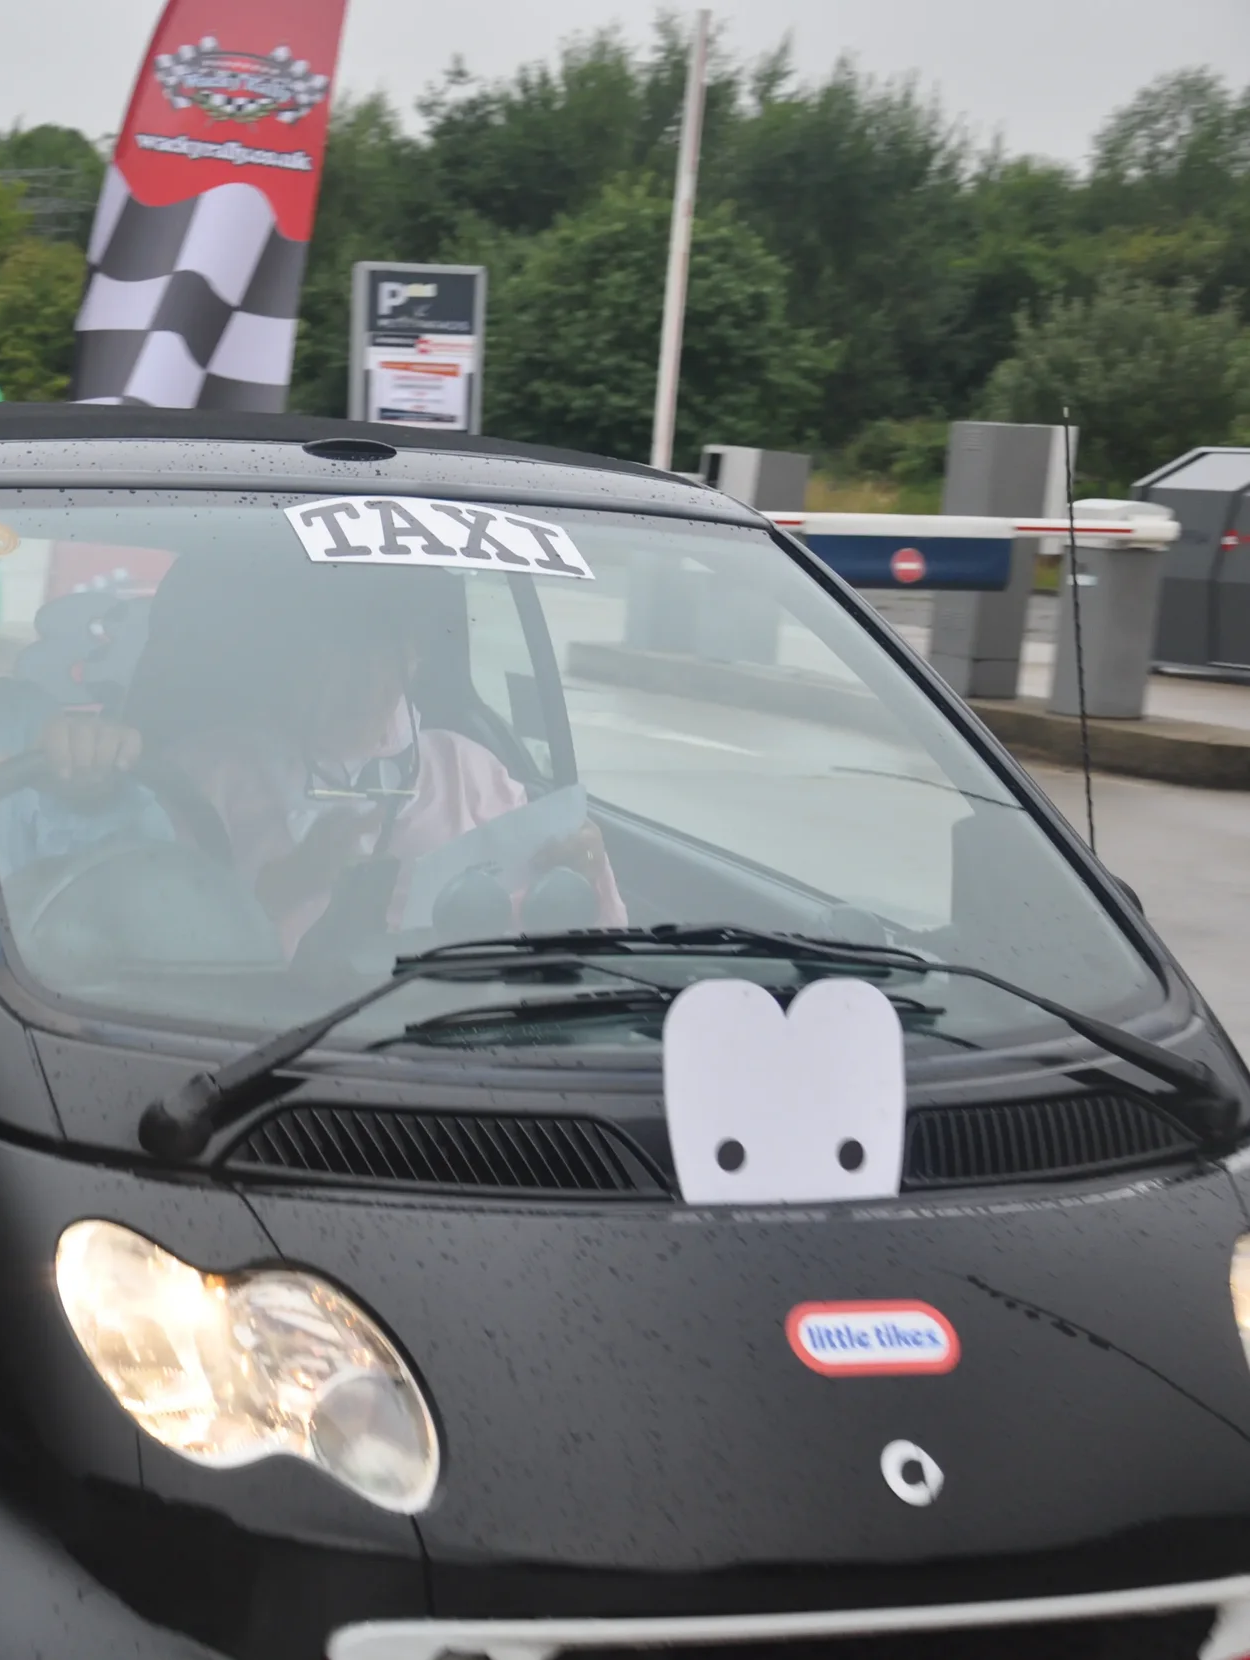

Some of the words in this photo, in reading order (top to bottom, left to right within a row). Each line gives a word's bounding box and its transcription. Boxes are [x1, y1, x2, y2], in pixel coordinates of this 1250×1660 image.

[300, 500, 586, 576] TAXI
[806, 1323, 870, 1350] little
[873, 1321, 943, 1349] tikes
